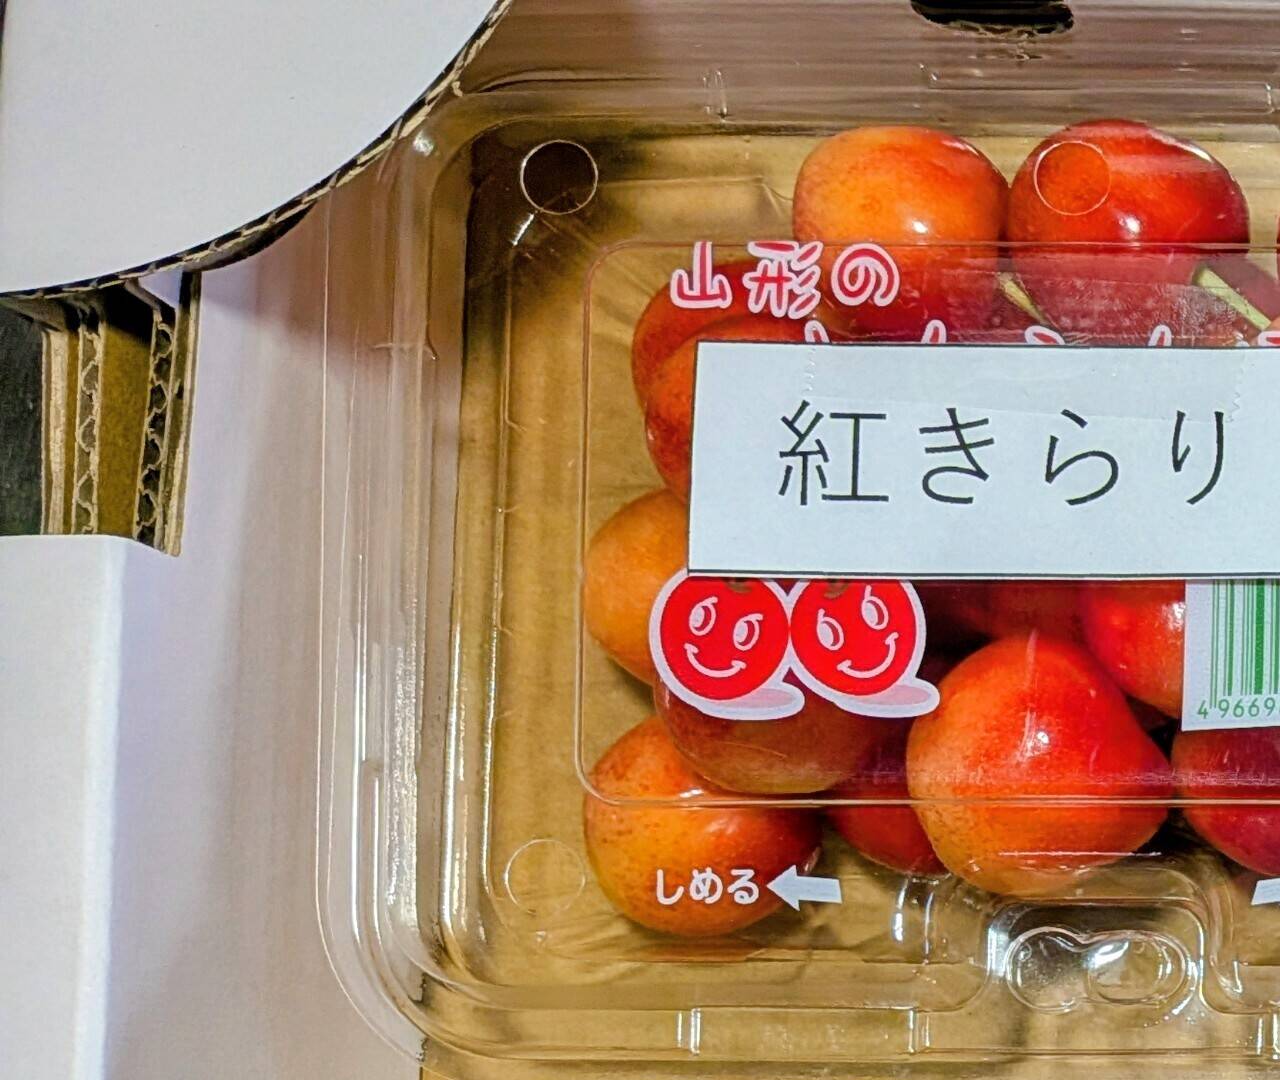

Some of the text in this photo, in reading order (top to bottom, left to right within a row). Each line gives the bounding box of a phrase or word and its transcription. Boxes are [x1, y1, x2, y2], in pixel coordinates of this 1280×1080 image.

[670, 241, 900, 318] 山形の
[778, 400, 1225, 506] 紅きらり
[655, 867, 760, 905] しめる
